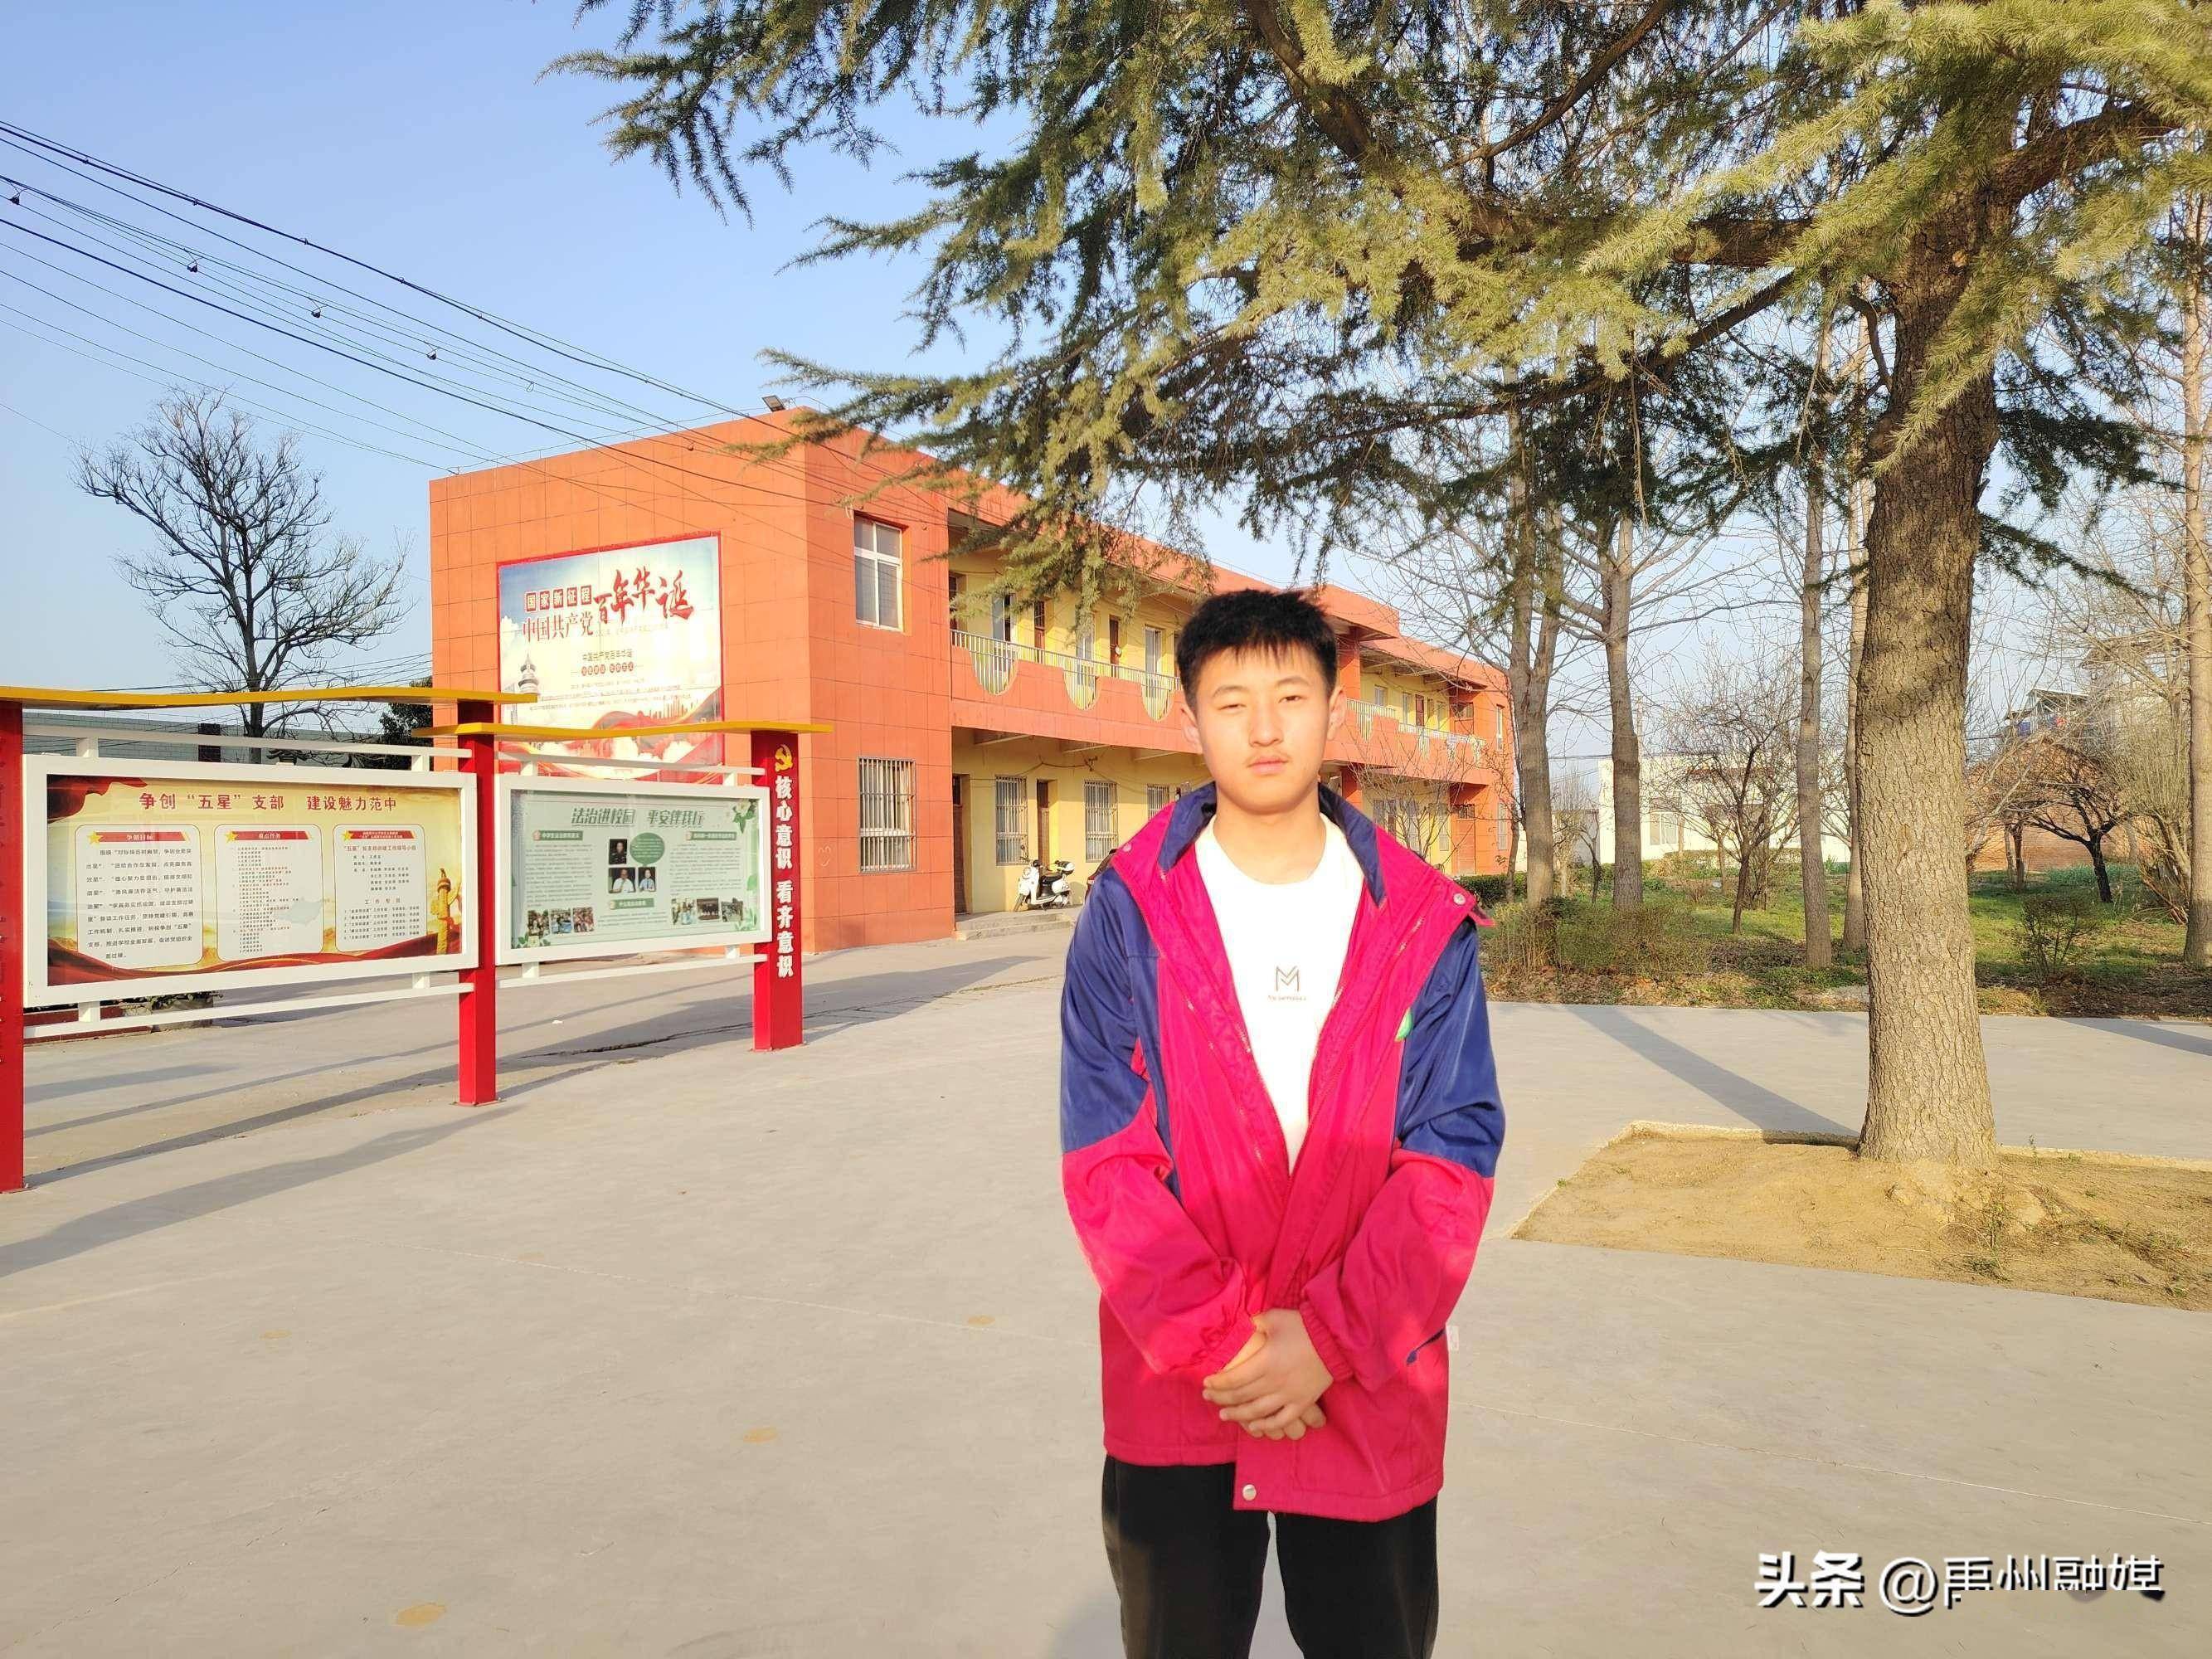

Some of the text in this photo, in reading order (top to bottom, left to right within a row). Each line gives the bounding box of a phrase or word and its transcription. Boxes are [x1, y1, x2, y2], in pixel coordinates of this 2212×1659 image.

[593, 566, 695, 625] 百年华诞
[522, 611, 594, 642] 中国共产党
[139, 793, 176, 810] 争创
[252, 795, 284, 810] 支部
[307, 795, 396, 811] 建设魅力范中
[571, 808, 704, 825] 法治进校园 平安伴我行
[775, 776, 795, 978] 核心意识 看齐意识
